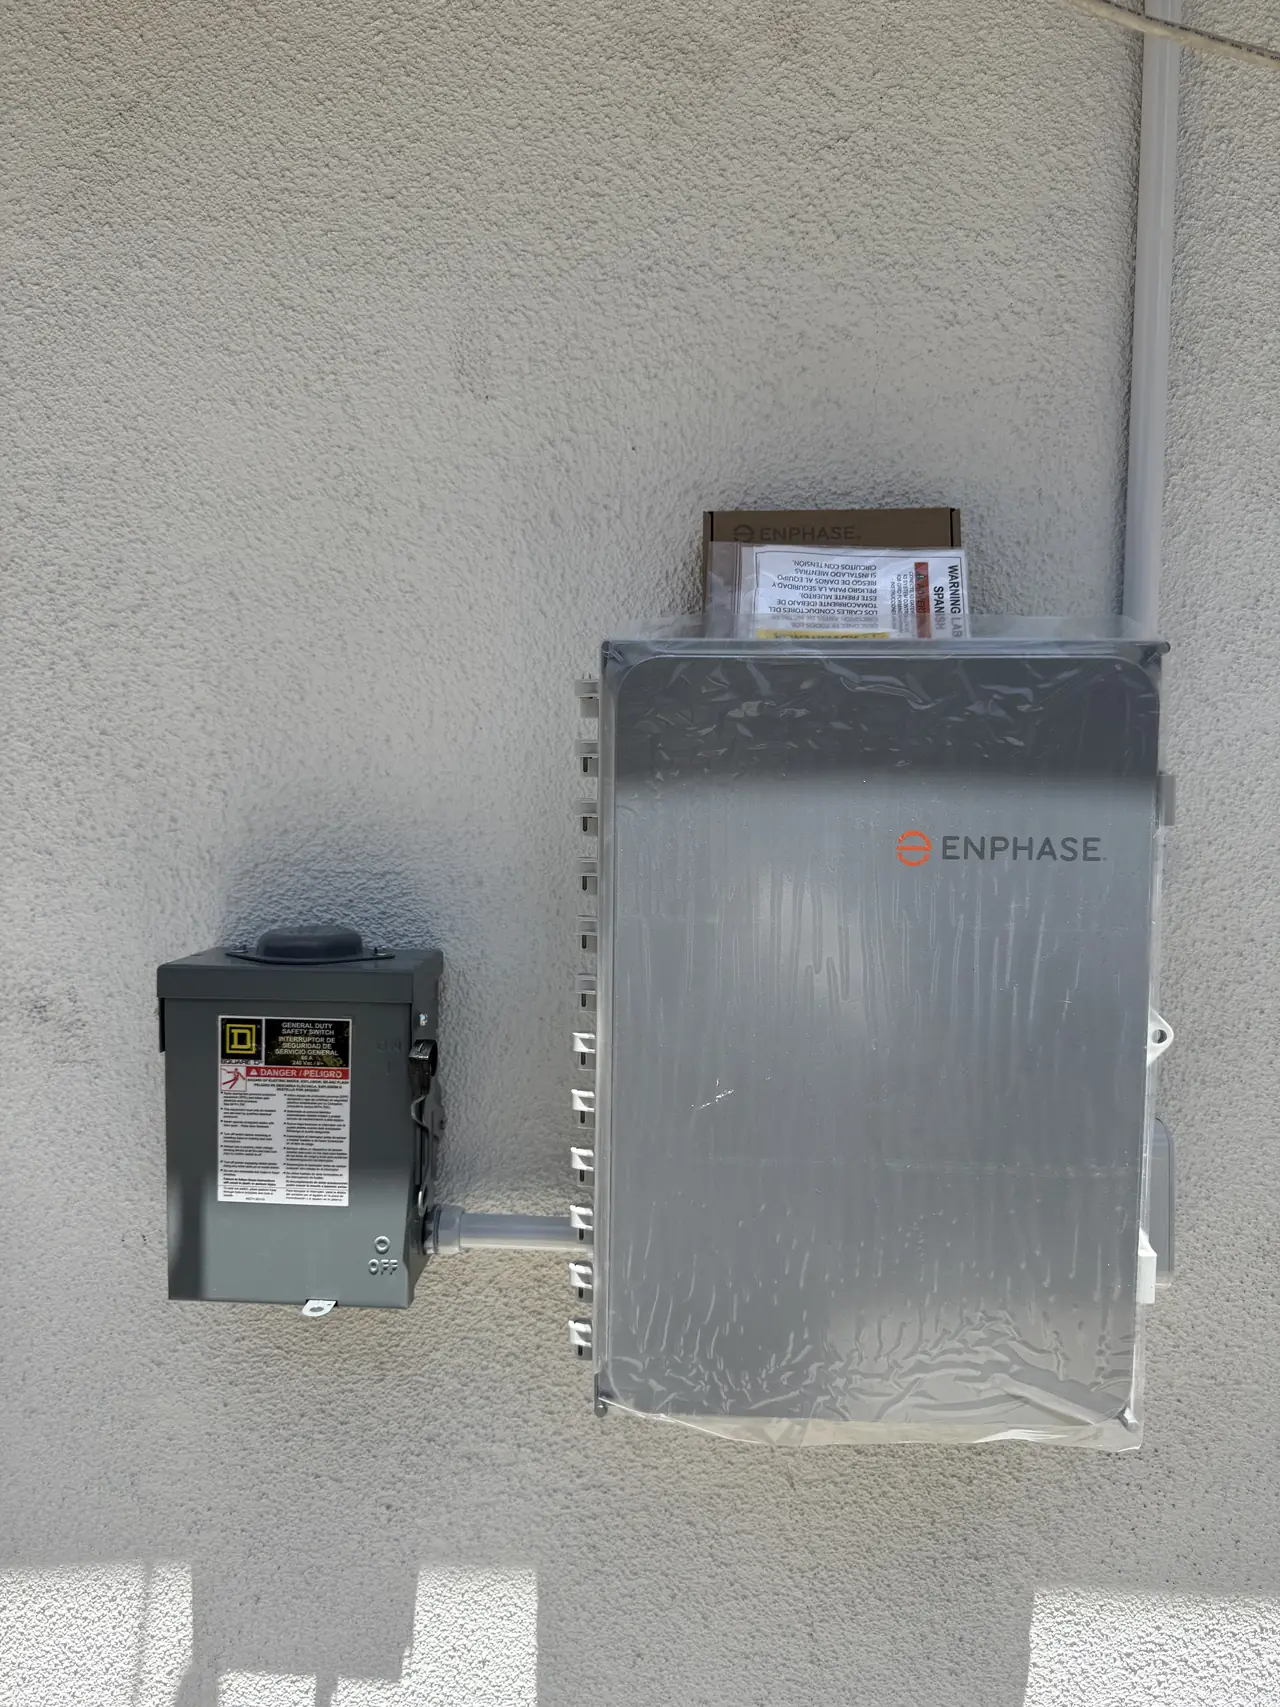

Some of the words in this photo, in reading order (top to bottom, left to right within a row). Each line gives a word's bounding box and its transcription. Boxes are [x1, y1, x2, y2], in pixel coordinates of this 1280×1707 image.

[760, 525, 856, 541] ENPHASE
[794, 568, 829, 577] MIENTRAS
[777, 574, 804, 583] EQUIPO
[777, 582, 817, 592] SEGURIDAD
[947, 564, 962, 614] WARNING
[782, 606, 836, 615] CONDUCTORES
[819, 601, 878, 609] TOMACORRIENTE
[933, 585, 946, 630] SPANISH
[941, 835, 1102, 862] ENPHASE
[260, 1068, 297, 1077] DANGER
[303, 1069, 343, 1079] PELIGRO
[368, 1258, 398, 1276] OFF
